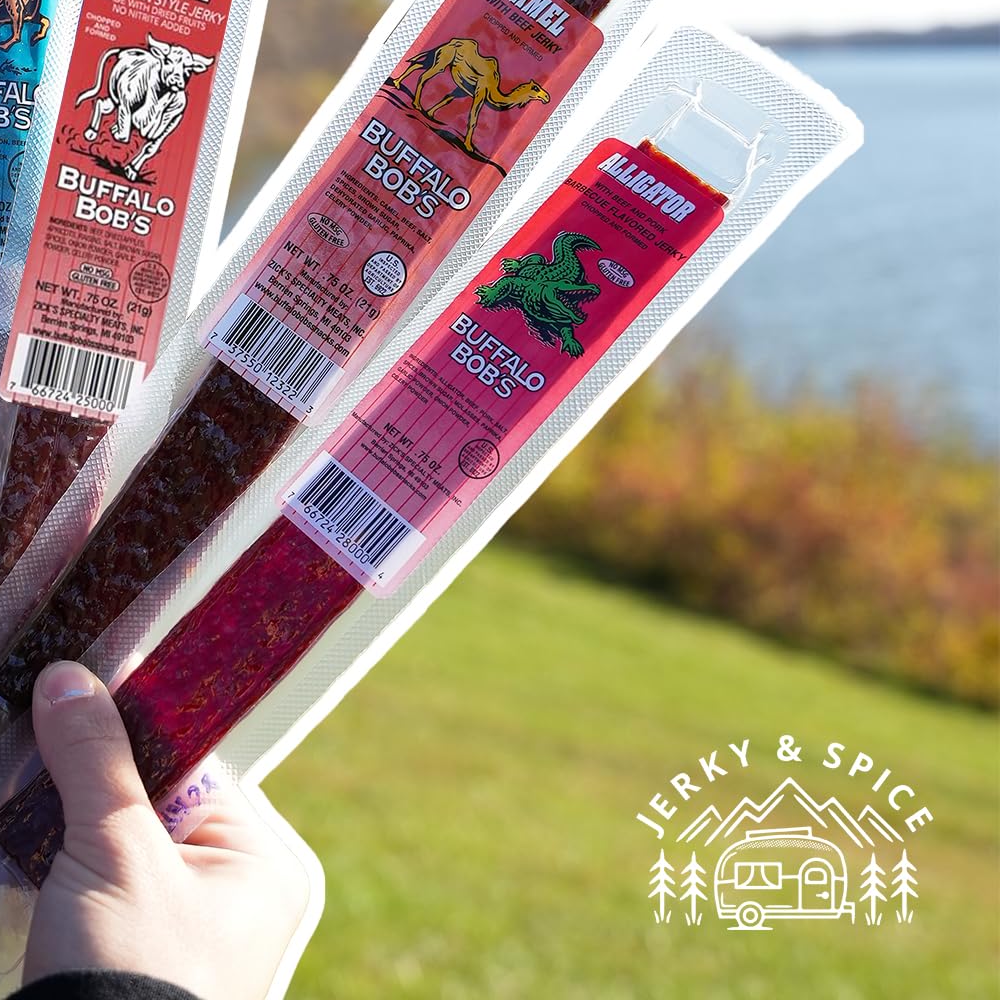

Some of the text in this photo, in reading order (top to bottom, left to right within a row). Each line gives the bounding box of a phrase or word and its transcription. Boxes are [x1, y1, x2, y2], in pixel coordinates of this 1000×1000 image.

[84, 26, 117, 42] FORMED
[85, 12, 121, 29] CHOPPED
[93, 21, 110, 32] AND
[111, 3, 191, 36] NO NITRITE ADDED
[150, 6, 177, 21] DRIED
[177, 15, 207, 31] FRUITS
[188, 4, 225, 26] JERKY
[482, 11, 543, 62] CHOPPED AND FORMED
[508, 11, 534, 34] BEEF
[530, 28, 562, 56] JERKY
[55, 163, 178, 219] BUFFALO
[357, 116, 476, 215] BUFFALO
[361, 150, 443, 221] BOB'S
[596, 146, 696, 227] ALLIGATOR
[72, 194, 154, 237] BOB'S
[305, 216, 346, 249] GLUTEN FREE
[318, 215, 343, 236] NO MSG
[563, 175, 686, 264] BARBECUE FLAVORED JERKY
[35, 279, 59, 294] NET
[82, 291, 101, 305] .75
[125, 302, 152, 318] (21g)
[266, 259, 367, 339] ZICK'S SPECIALTY MEATS, INC.
[283, 240, 303, 259] NET
[321, 269, 338, 285] .75
[338, 282, 356, 300] OZ.
[353, 295, 381, 321] (21g)
[267, 275, 352, 342] Berrien Springs, MI 49103
[209, 332, 313, 414] 7 37550 12322 3
[448, 311, 549, 395] BUFFALO
[448, 339, 519, 401] BOB'S
[30, 383, 114, 413] 66724 25000
[382, 421, 401, 439] NET
[413, 447, 430, 463] .75
[427, 459, 444, 475] OZ.
[302, 503, 335, 534] 66724
[334, 531, 370, 564] 28000
[376, 570, 385, 579] 4
